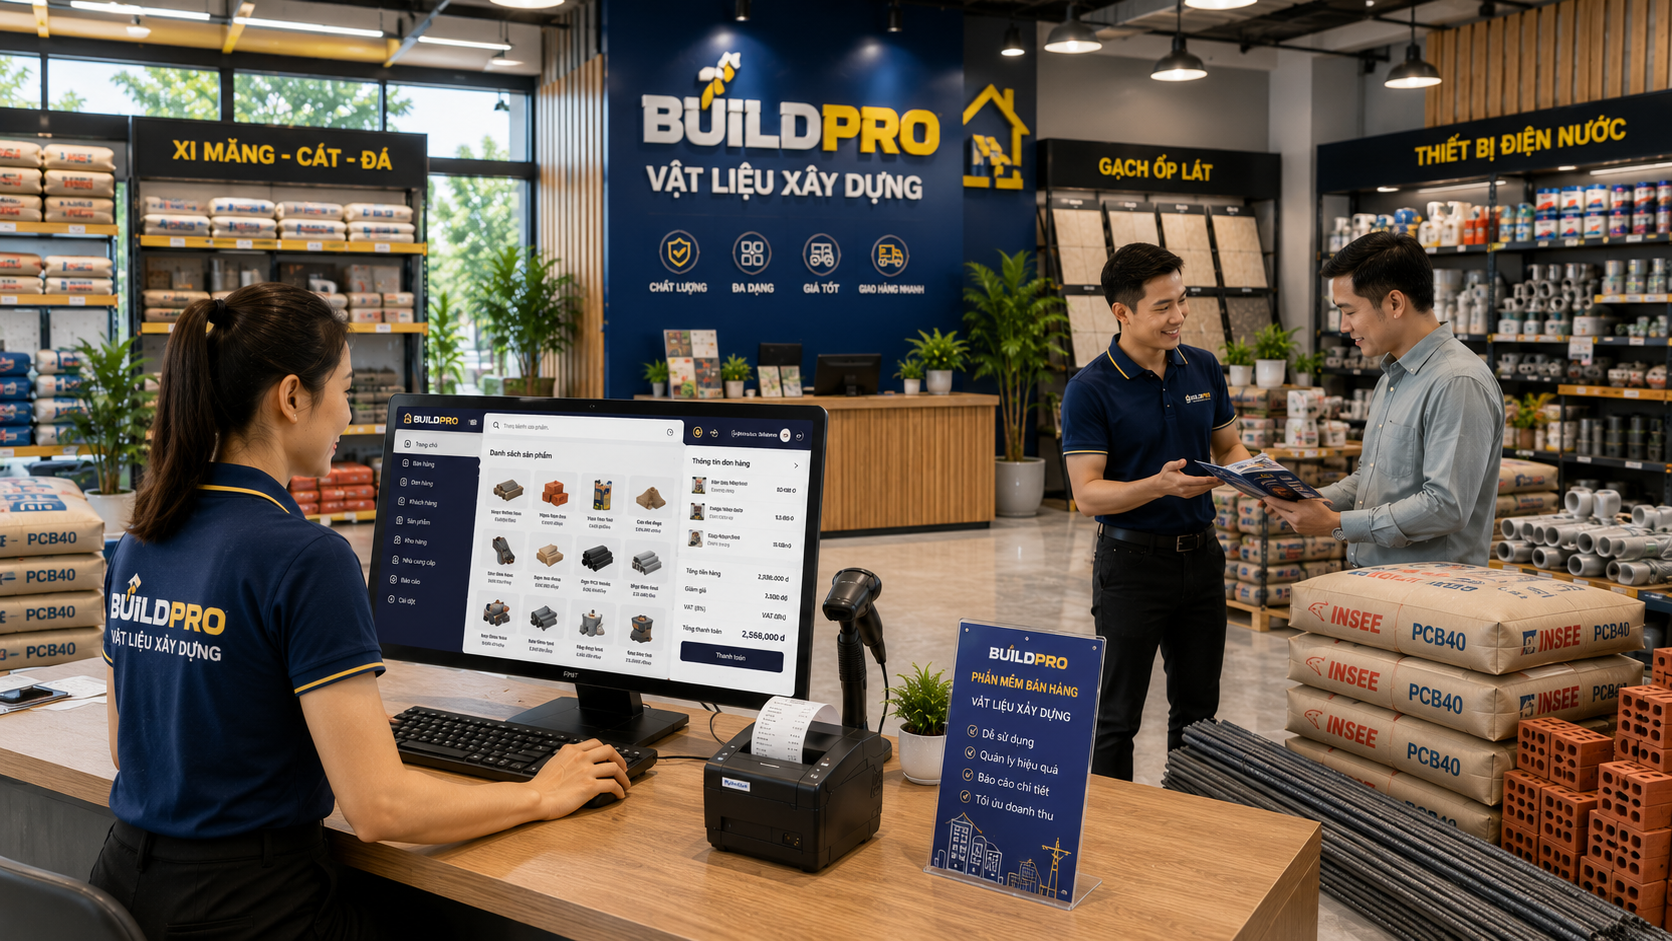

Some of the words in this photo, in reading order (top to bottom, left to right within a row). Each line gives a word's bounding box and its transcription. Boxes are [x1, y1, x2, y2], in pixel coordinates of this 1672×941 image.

[642, 94, 940, 156] BUILDPRO
[172, 139, 196, 162] XI
[204, 138, 276, 165] MĂNG
[296, 143, 342, 168] CÁT
[360, 147, 392, 170] ĐÁ
[1414, 133, 1471, 166] THIẾT
[1476, 136, 1495, 162] BỊ
[1500, 126, 1551, 156] ĐIỆN
[1558, 114, 1627, 148] NƯỚC
[646, 159, 704, 198] VẬT
[711, 162, 774, 200] LIỆU
[781, 164, 839, 197] XÂY
[844, 171, 922, 204] DỰNG
[1099, 157, 1149, 180] GẠCH
[1153, 154, 1178, 180] ỐP
[1182, 158, 1213, 182] LÁT
[732, 282, 746, 293] ĐA
[748, 282, 774, 296] DẠNG
[803, 281, 820, 294] GIÁ
[822, 281, 840, 294] TỐT
[414, 415, 459, 425] BUILDPRO
[28, 532, 77, 546] PCB40
[26, 568, 76, 583] PCB40
[26, 606, 76, 621] PCB40
[110, 592, 226, 636] BUILDPRO
[1331, 606, 1383, 634] INSEE
[26, 642, 76, 658] PCB40
[178, 640, 222, 662] DỰNG
[1412, 622, 1466, 652] PCB40
[1538, 624, 1581, 652] INSEE
[1594, 622, 1630, 642] PCB40
[989, 646, 1068, 670] BUILDPRO
[1328, 660, 1380, 692] INSEE
[1408, 683, 1462, 714] PCB40
[1537, 686, 1580, 716] INSEE
[1040, 708, 1071, 722] DỰNG
[1010, 734, 1034, 750] dụng
[1326, 714, 1378, 748] INSEE
[1407, 742, 1460, 777] PCB40
[1017, 782, 1032, 792] chi
[1005, 802, 1035, 816] doanh
[1038, 808, 1054, 821] thu
